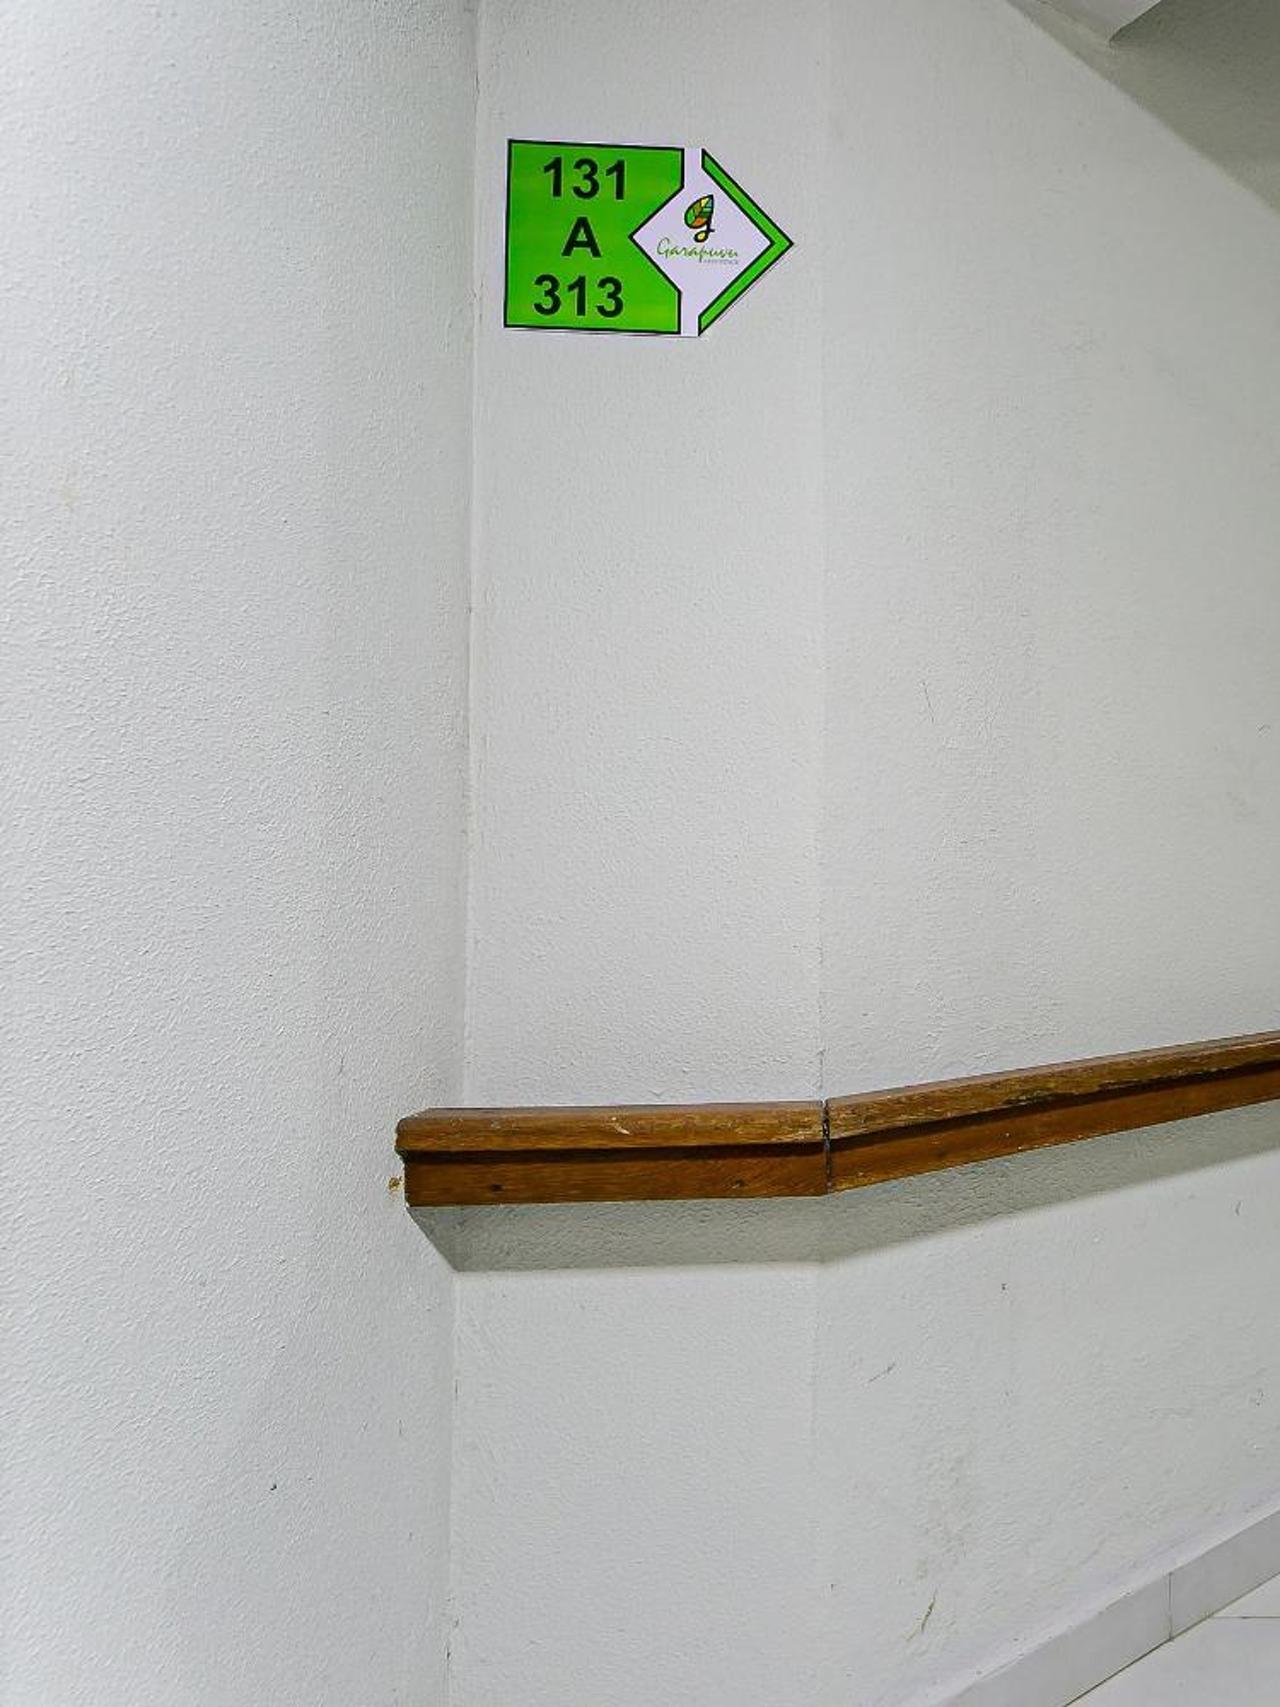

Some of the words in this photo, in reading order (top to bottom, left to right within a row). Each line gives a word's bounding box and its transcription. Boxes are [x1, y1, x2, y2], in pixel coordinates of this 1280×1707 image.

[544, 156, 625, 200] 131
[561, 216, 602, 258] A
[533, 274, 624, 318] 313
